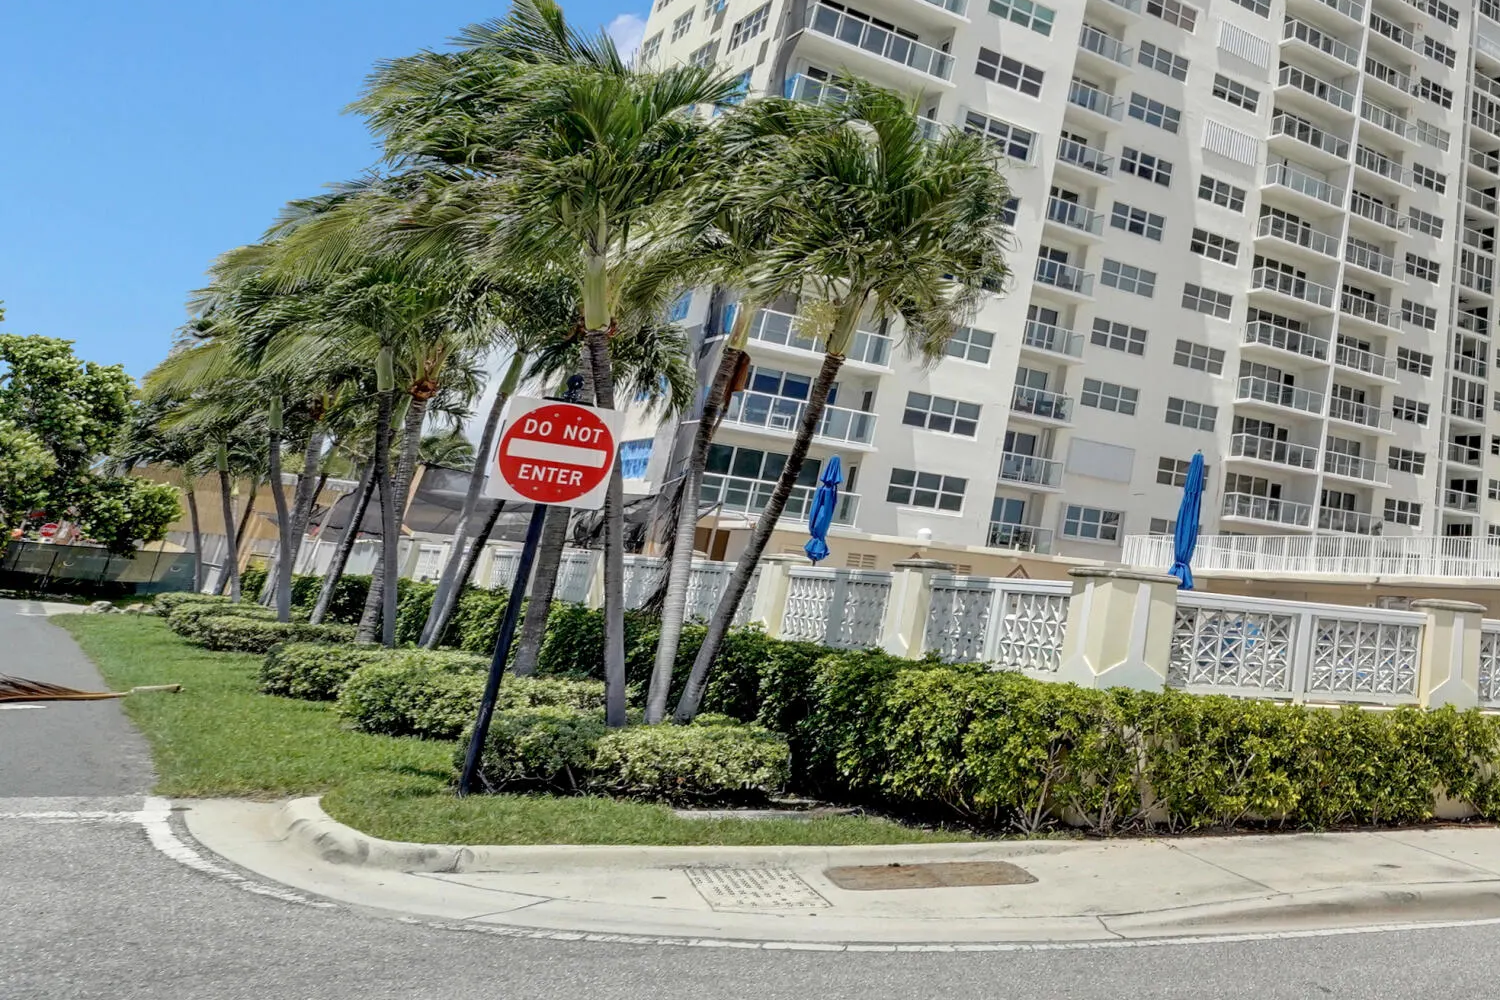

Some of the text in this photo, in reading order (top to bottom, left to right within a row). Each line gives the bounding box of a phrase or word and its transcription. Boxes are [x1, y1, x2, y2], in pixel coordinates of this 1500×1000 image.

[523, 418, 604, 444] DO NOT
[517, 464, 584, 486] ENTER
